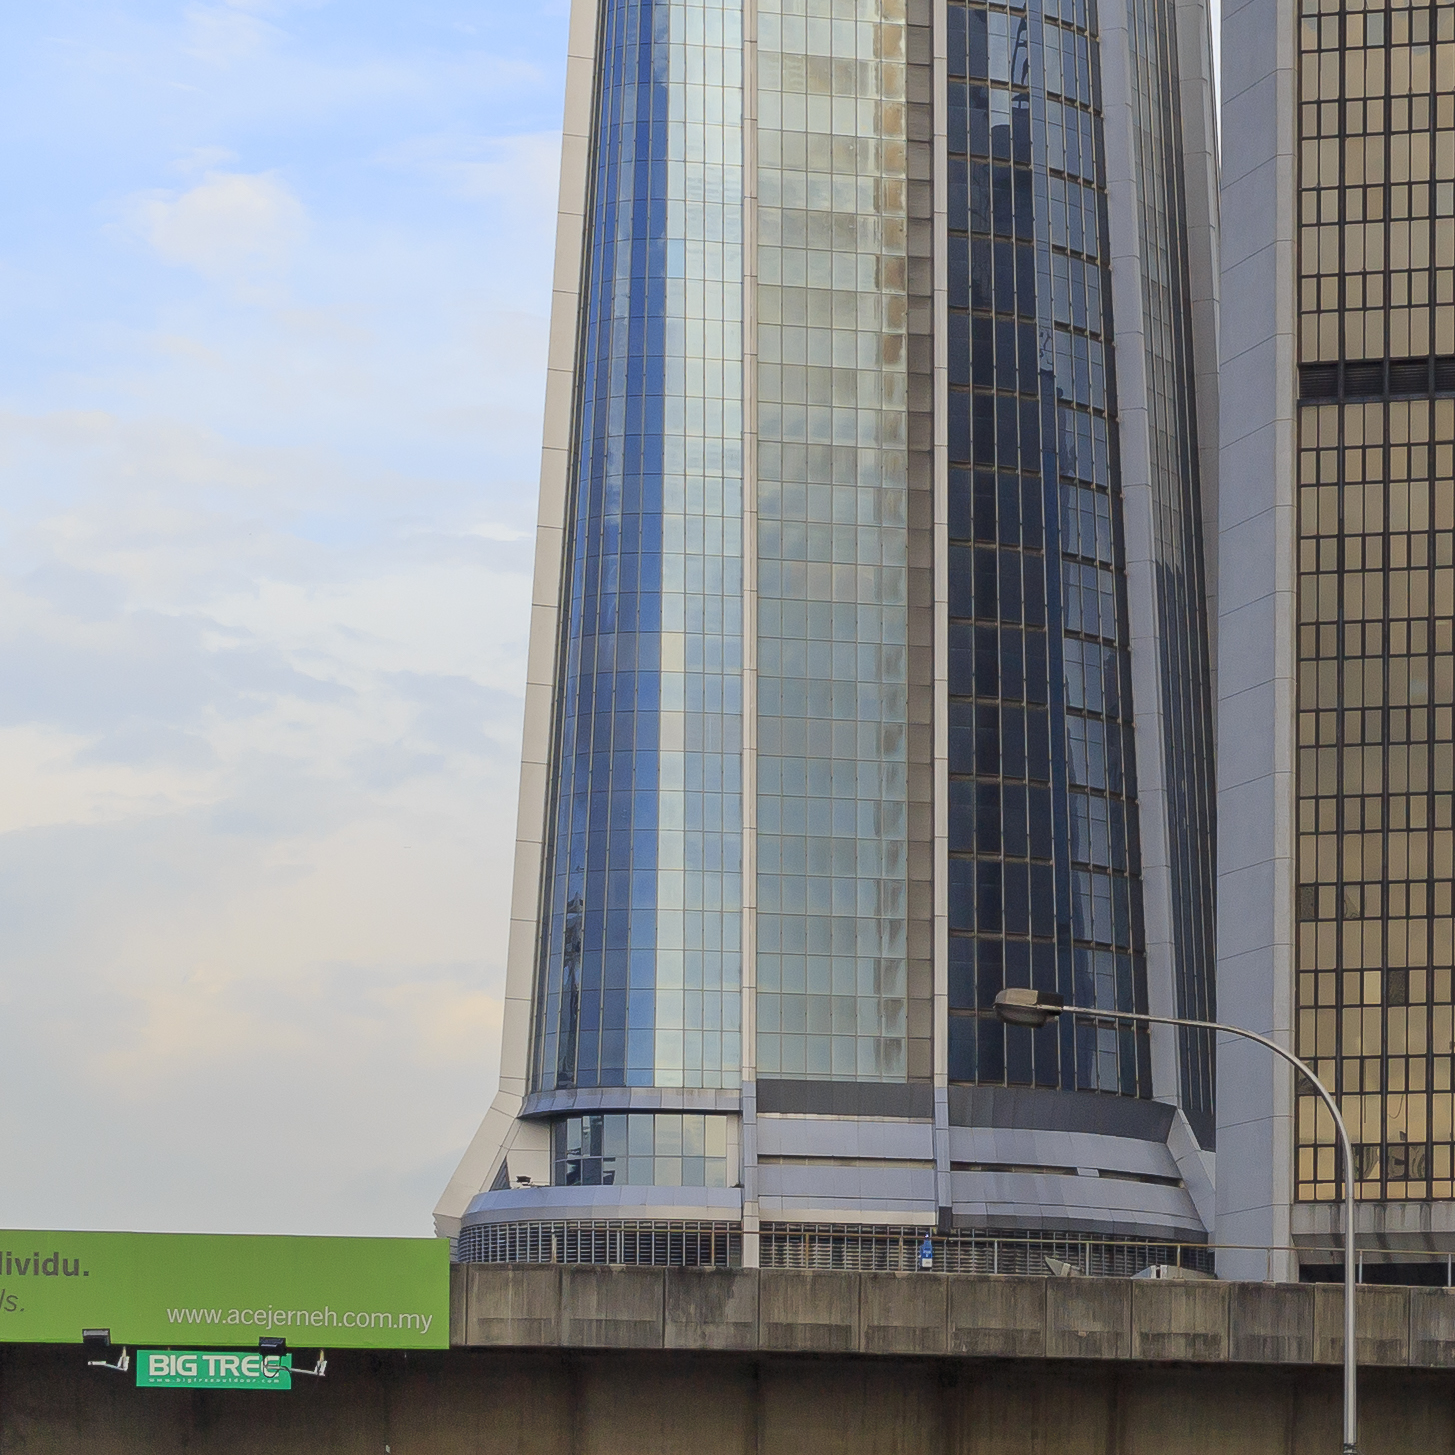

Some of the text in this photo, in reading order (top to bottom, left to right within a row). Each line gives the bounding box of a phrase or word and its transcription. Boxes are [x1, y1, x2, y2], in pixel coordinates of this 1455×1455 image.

[0, 1251, 90, 1277] ividu.
[166, 1304, 433, 1334] www.acejerneh.com.my
[149, 1354, 198, 1377] BIG
